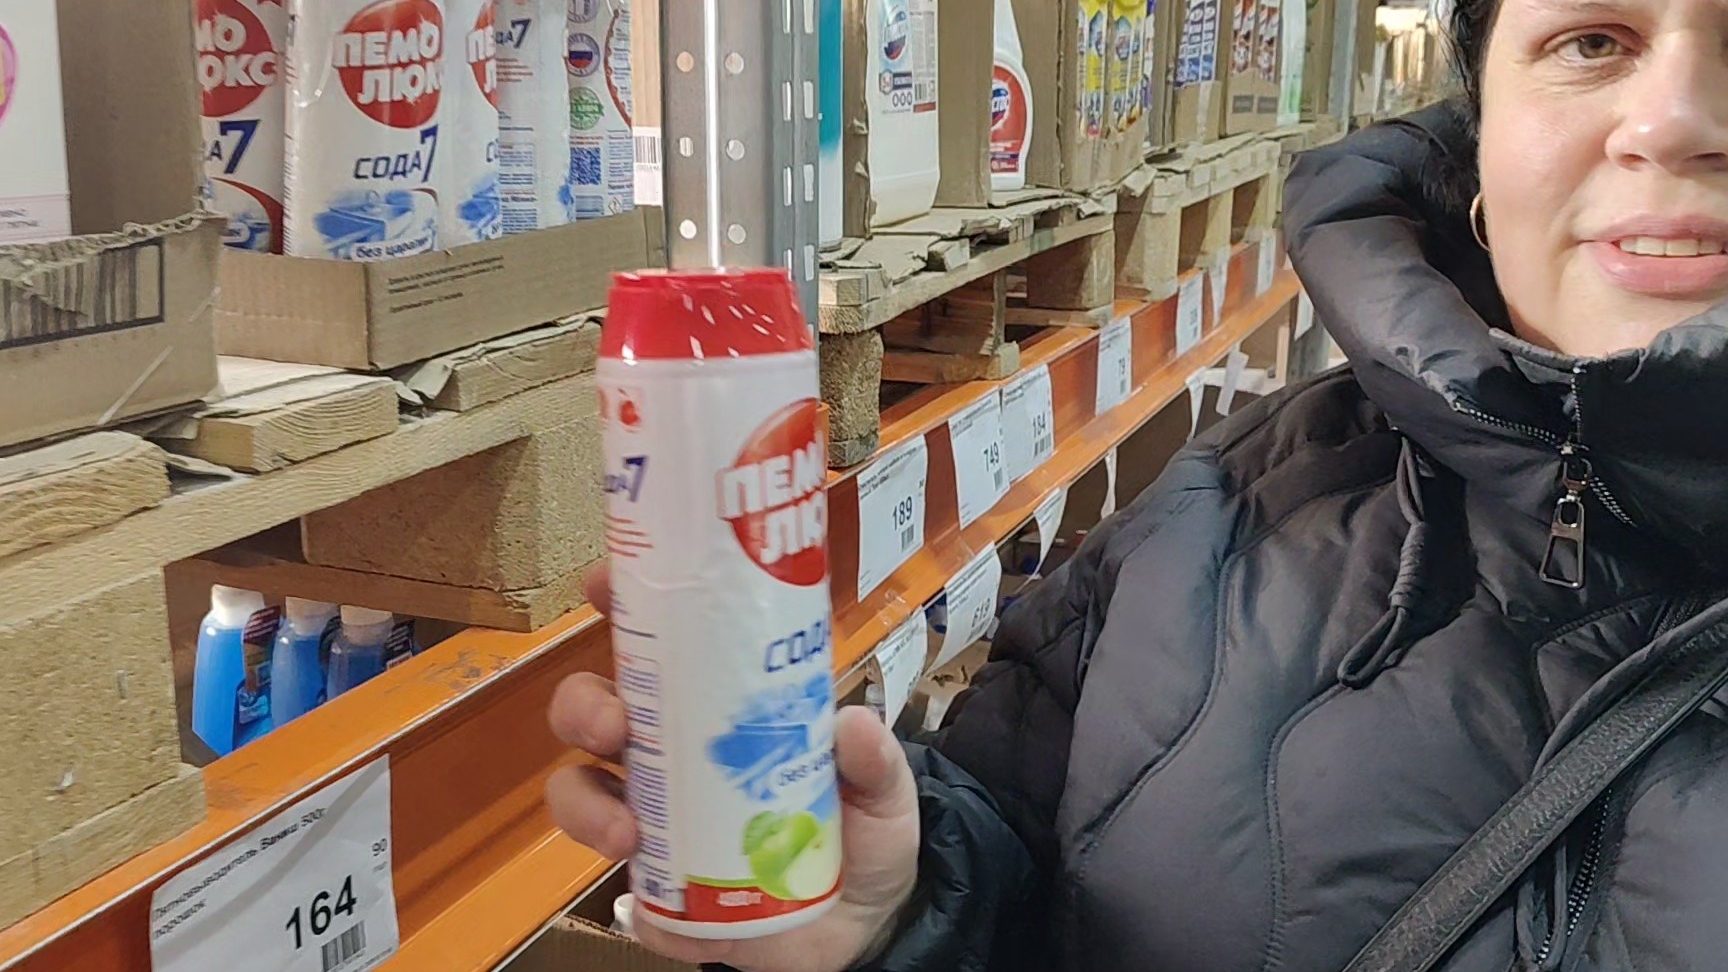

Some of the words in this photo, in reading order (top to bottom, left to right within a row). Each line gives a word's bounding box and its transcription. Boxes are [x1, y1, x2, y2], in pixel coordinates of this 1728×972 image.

[333, 20, 440, 67] ПЕМО
[198, 51, 277, 91] ЮКС
[357, 60, 445, 105] ЛЮК
[219, 119, 261, 174] 7
[715, 430, 826, 520] ПЕМ
[983, 441, 999, 472] 749
[891, 496, 912, 531] 189
[765, 616, 830, 672] СОД
[285, 874, 357, 950] 164
